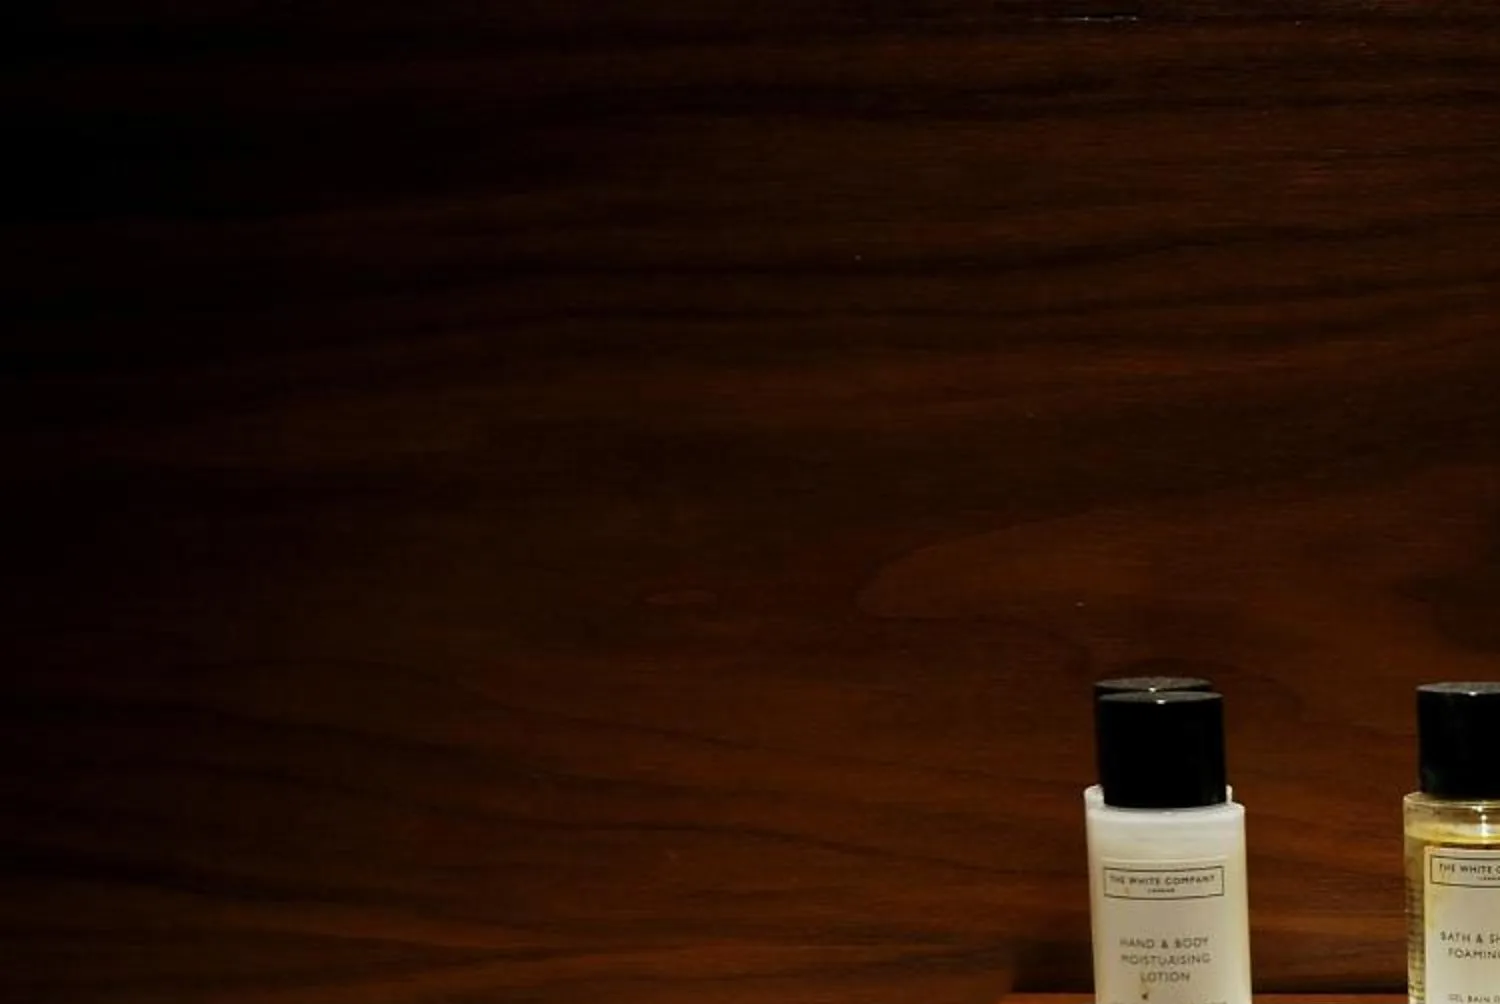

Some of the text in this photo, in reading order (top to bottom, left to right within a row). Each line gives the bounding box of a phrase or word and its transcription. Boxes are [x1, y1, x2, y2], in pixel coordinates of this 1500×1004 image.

[1439, 862, 1456, 873] THE
[1460, 864, 1493, 875] WHITE
[1109, 873, 1216, 886] THE WHITE COMPANY
[1119, 936, 1155, 949] HAND
[1174, 936, 1209, 949] BODY
[1440, 930, 1471, 944] BATH
[1475, 932, 1484, 944] &
[1120, 951, 1212, 966] MOISTURISING
[1140, 970, 1190, 983] LOTION
